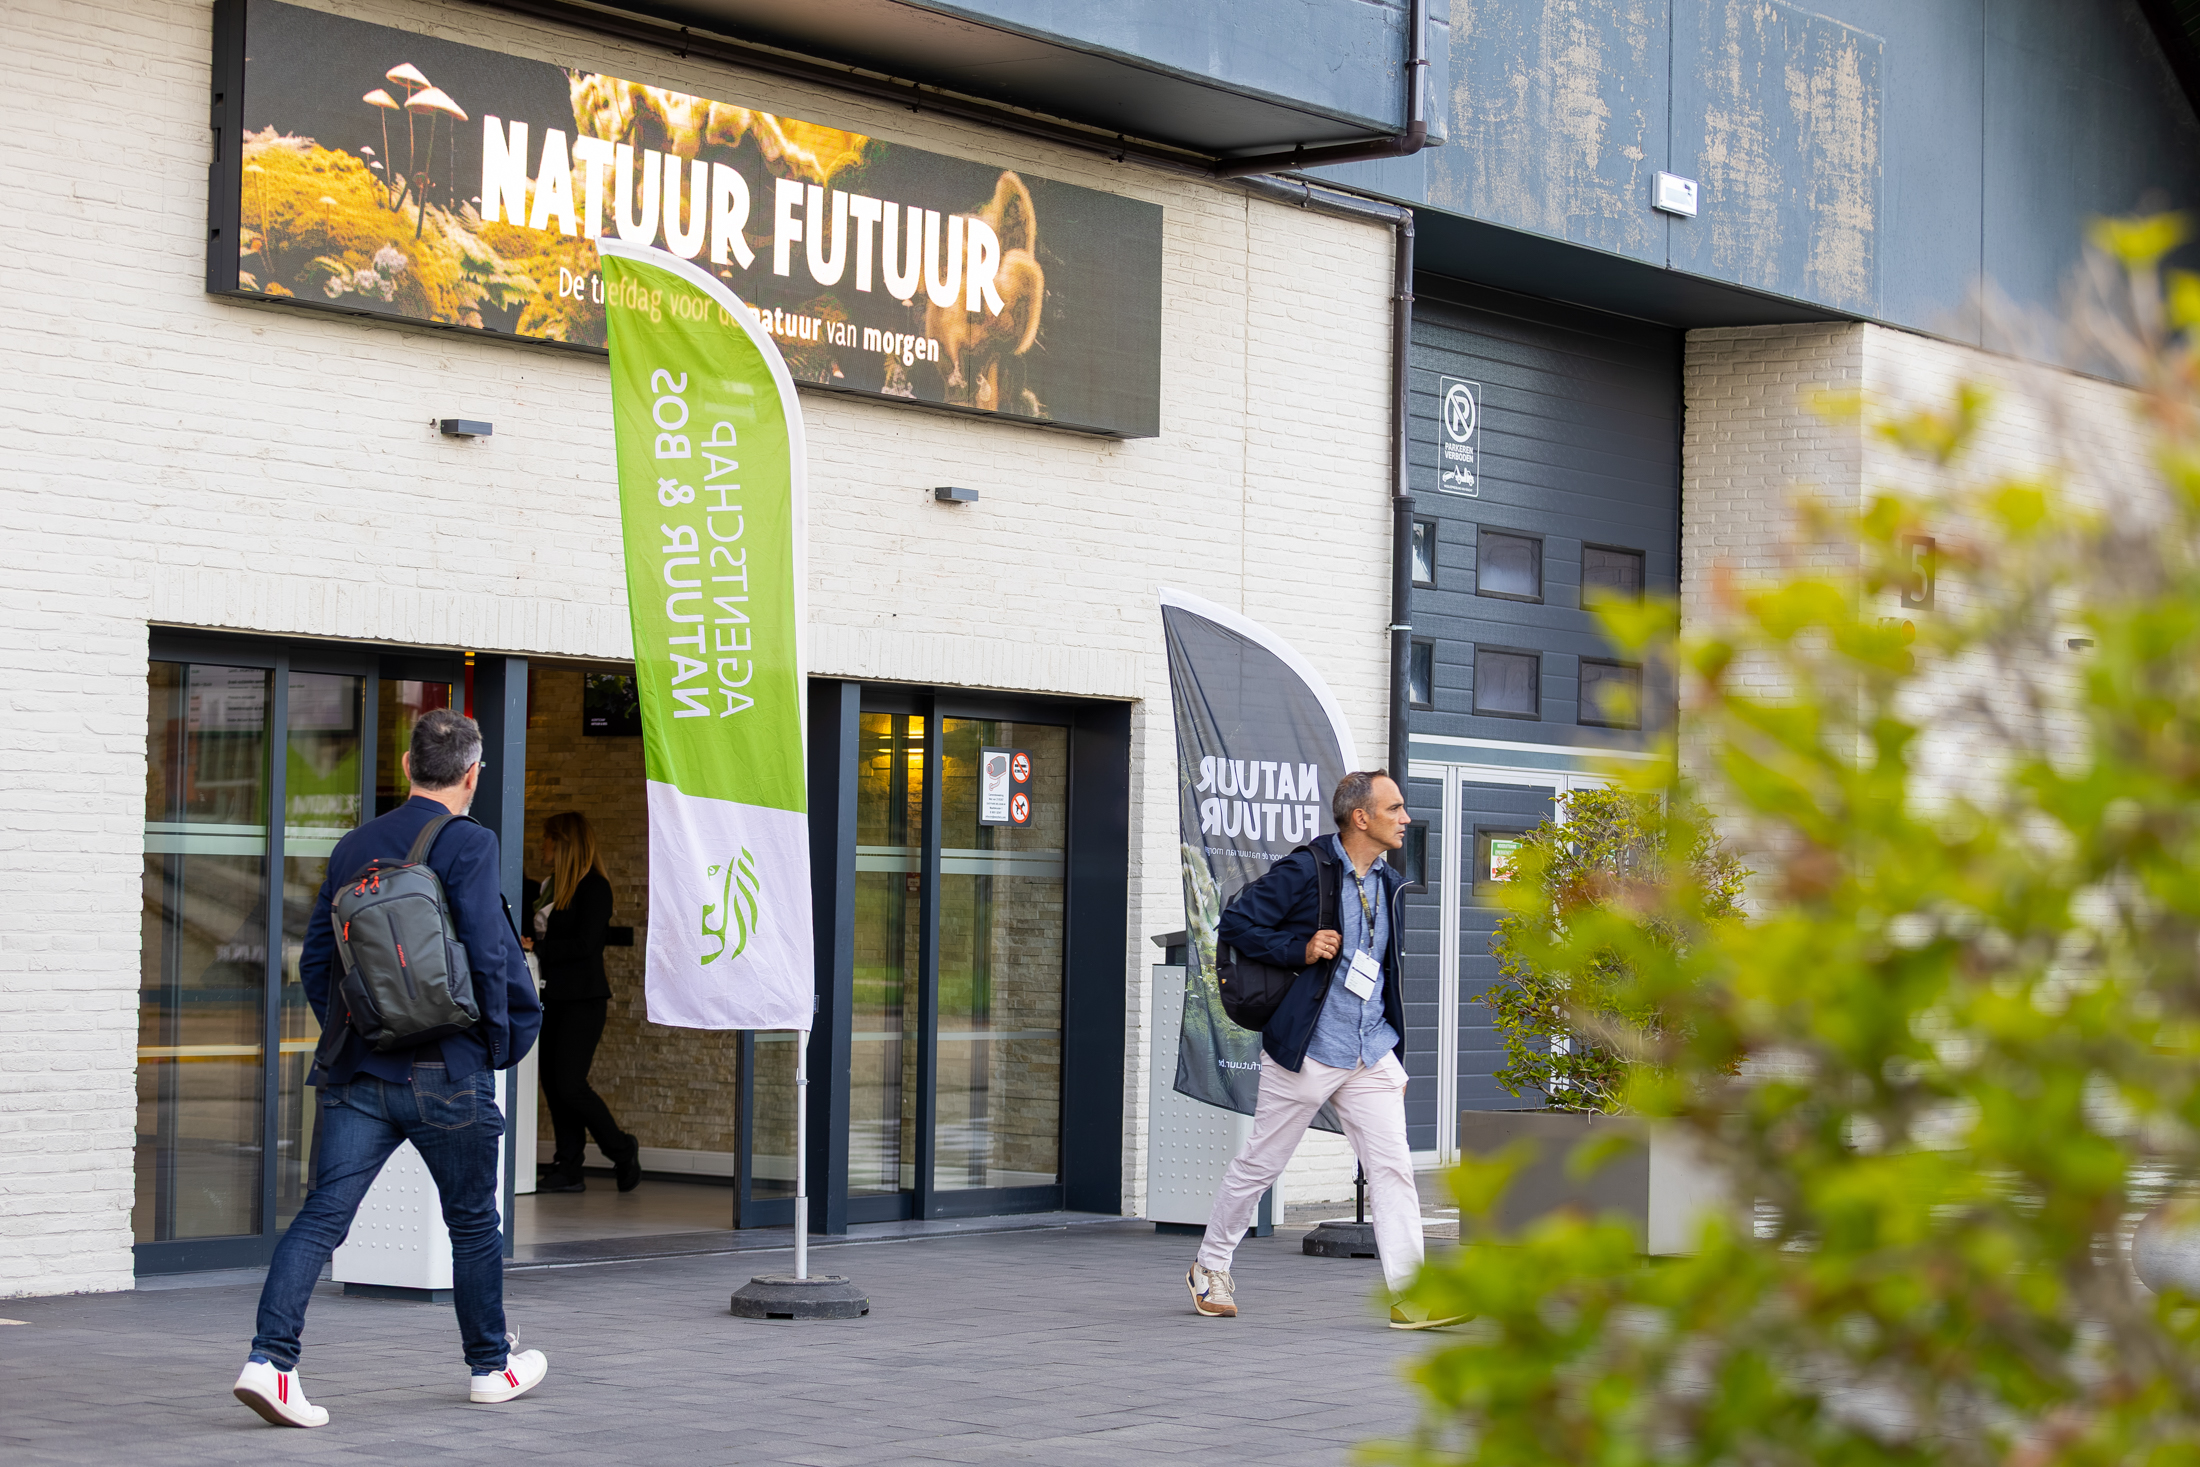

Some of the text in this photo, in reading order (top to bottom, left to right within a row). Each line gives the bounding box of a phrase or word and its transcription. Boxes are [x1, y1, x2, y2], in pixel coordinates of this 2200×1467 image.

[481, 114, 1006, 318] NATUUR FUTUUR
[559, 267, 585, 301] De
[669, 292, 713, 323] voor
[826, 320, 857, 348] van
[863, 326, 939, 367] morgen
[1445, 442, 1473, 454] PARKEREN
[1445, 450, 1473, 463] VERBODEN
[1910, 543, 1928, 602] 5
